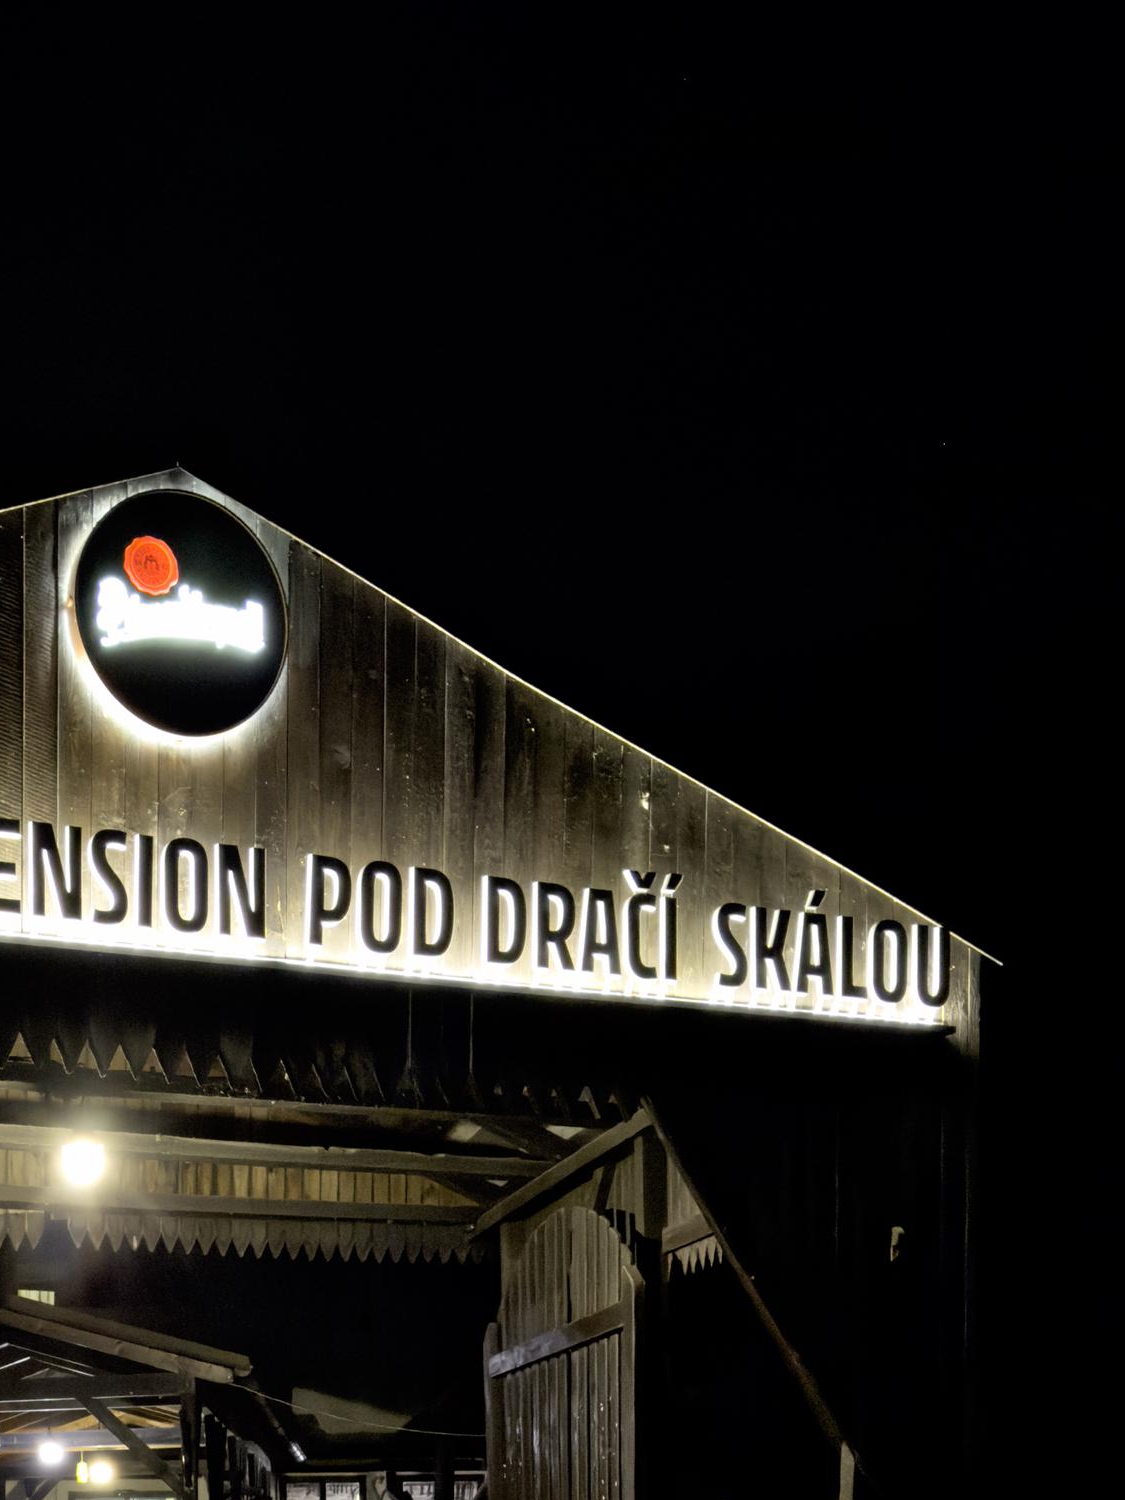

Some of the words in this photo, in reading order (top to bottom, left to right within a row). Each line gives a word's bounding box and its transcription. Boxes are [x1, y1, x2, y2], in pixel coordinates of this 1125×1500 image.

[306, 852, 455, 957] POD
[481, 868, 683, 981] DRAČÍ
[712, 890, 950, 1007] SKÁLOU
